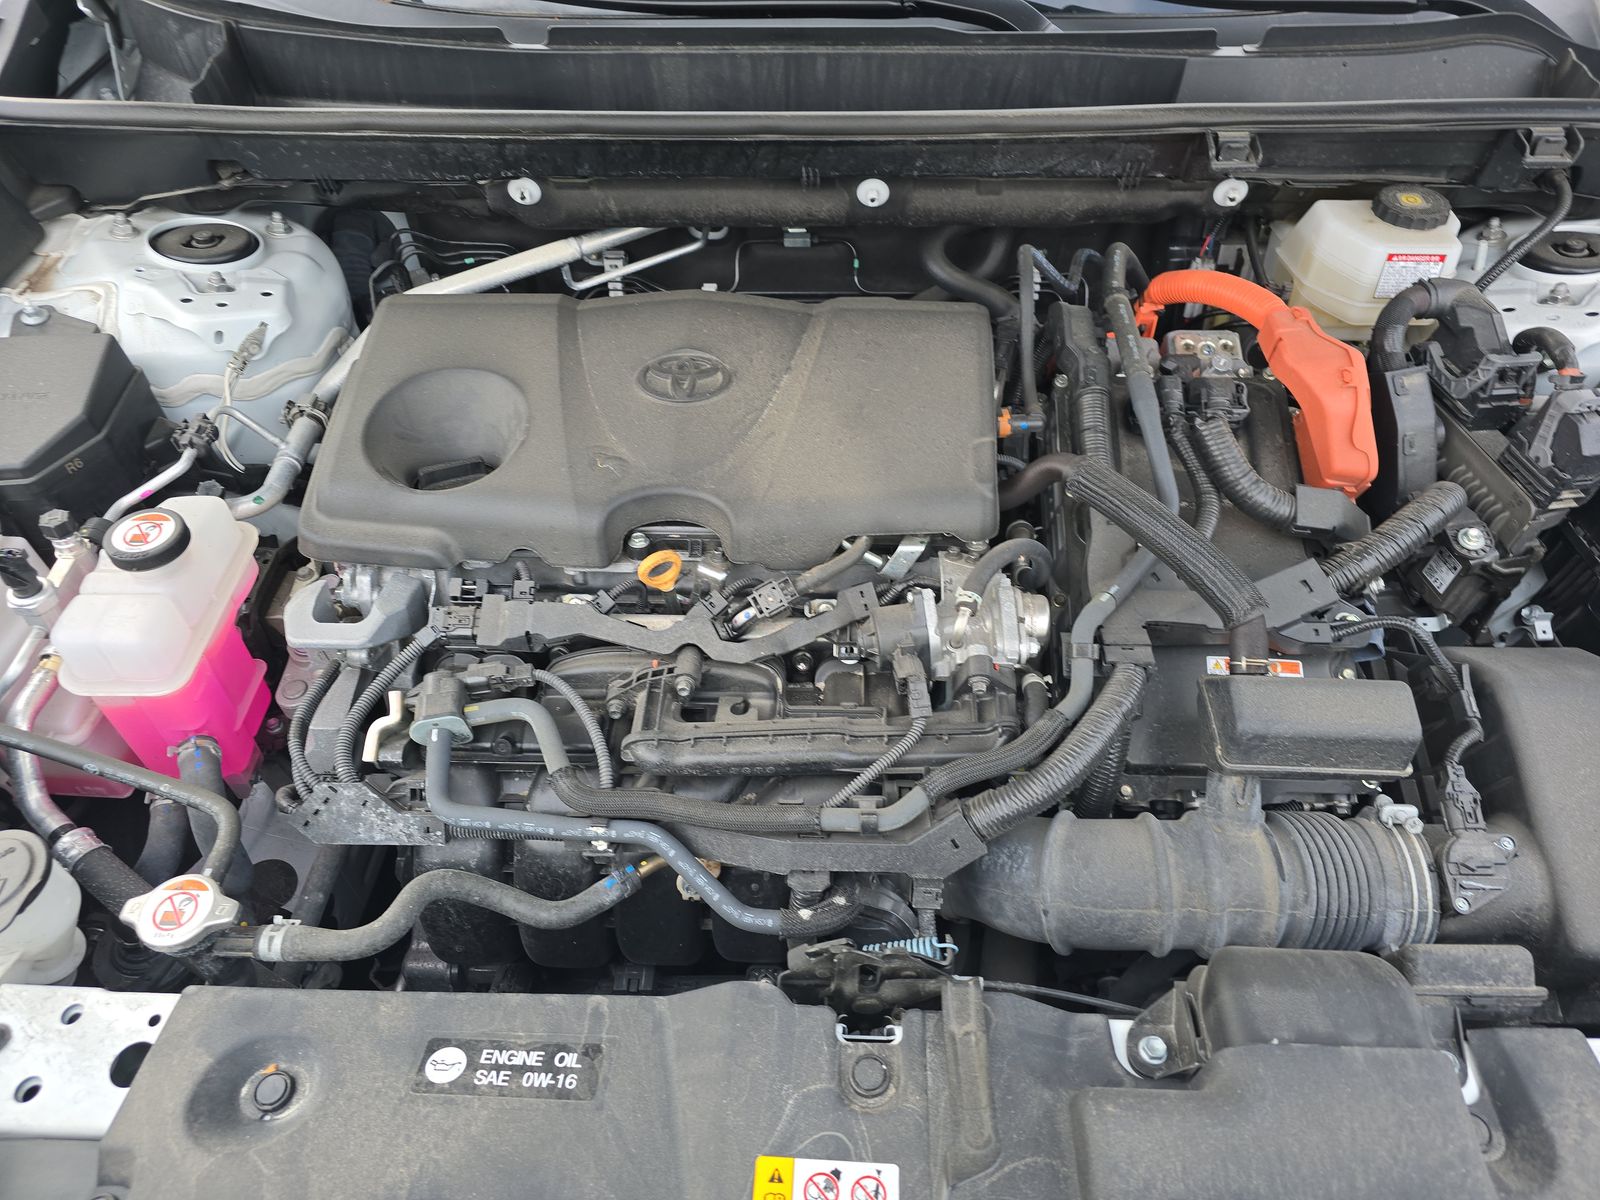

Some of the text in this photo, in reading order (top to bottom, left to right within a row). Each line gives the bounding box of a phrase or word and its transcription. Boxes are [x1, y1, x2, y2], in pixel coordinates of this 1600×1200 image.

[479, 1049, 582, 1068] ENGINE OIL
[473, 1069, 578, 1089] SAE 0W-16
